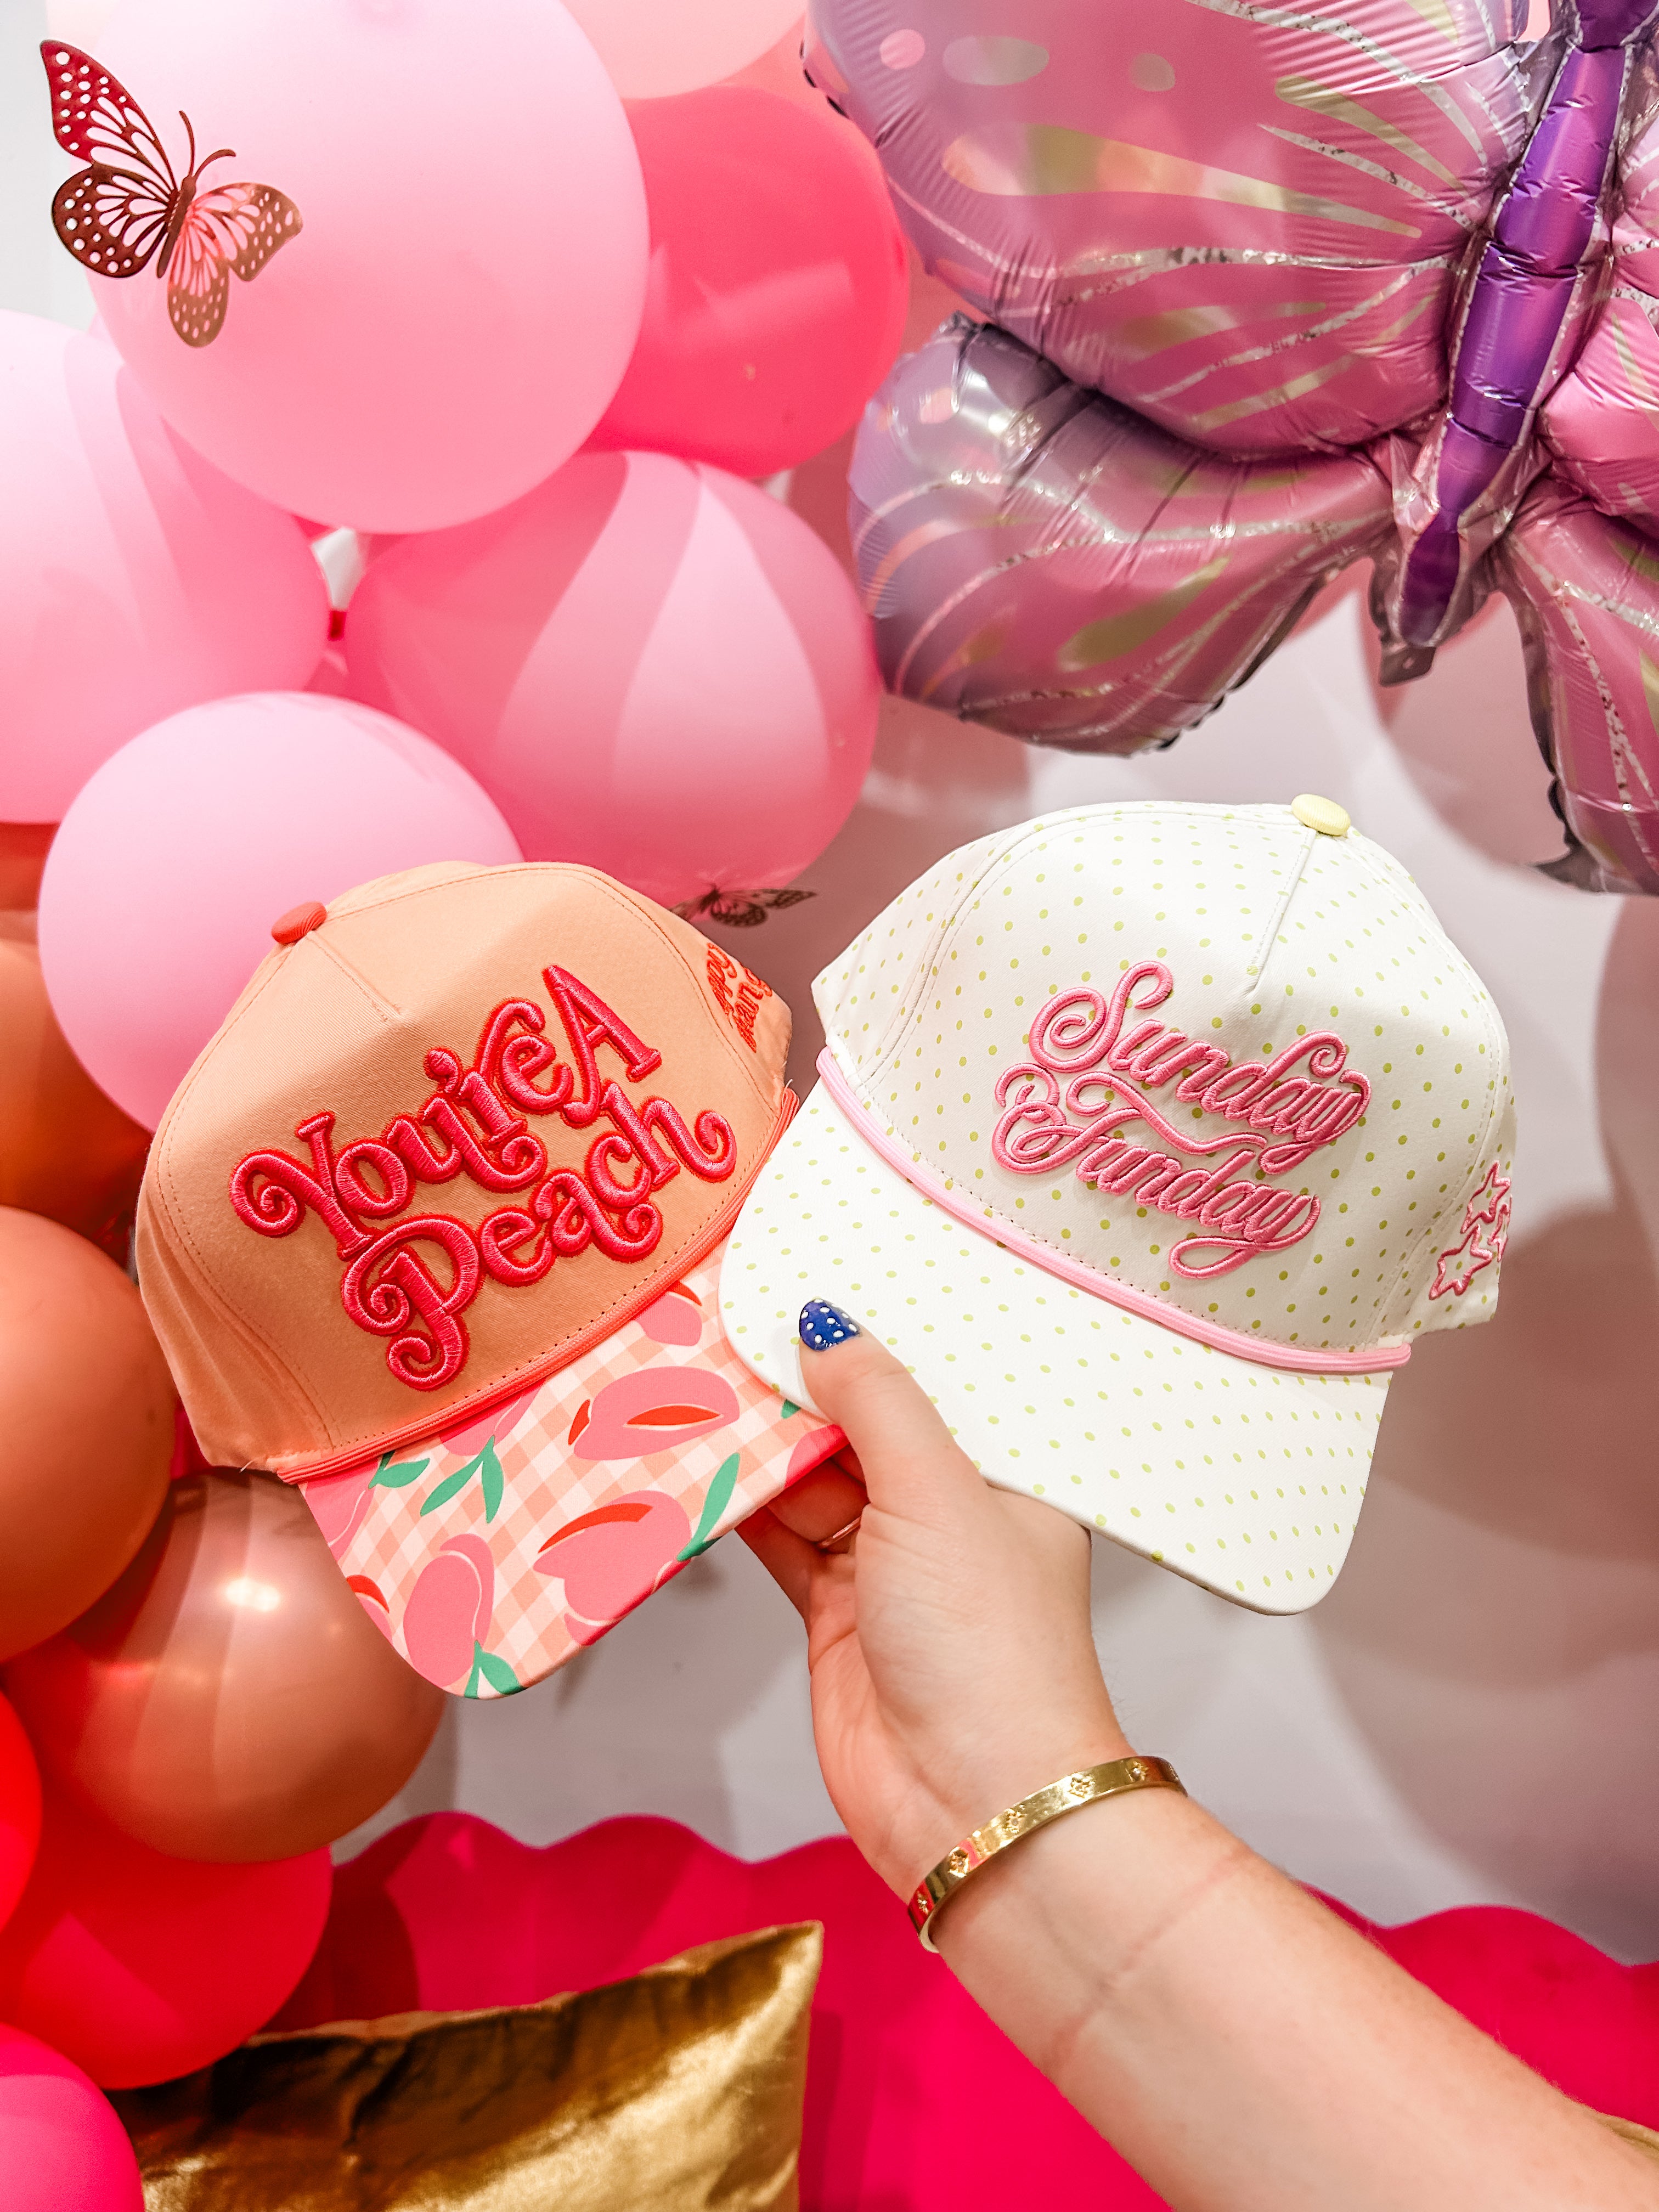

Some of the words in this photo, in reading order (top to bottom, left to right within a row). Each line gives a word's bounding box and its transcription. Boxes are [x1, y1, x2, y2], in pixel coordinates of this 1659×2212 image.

[228, 997, 574, 1261] You're
[542, 963, 663, 1127] A
[992, 1063, 1321, 1279] Funday
[1029, 961, 1371, 1175] Sunday
[340, 1079, 738, 1391] Peach
